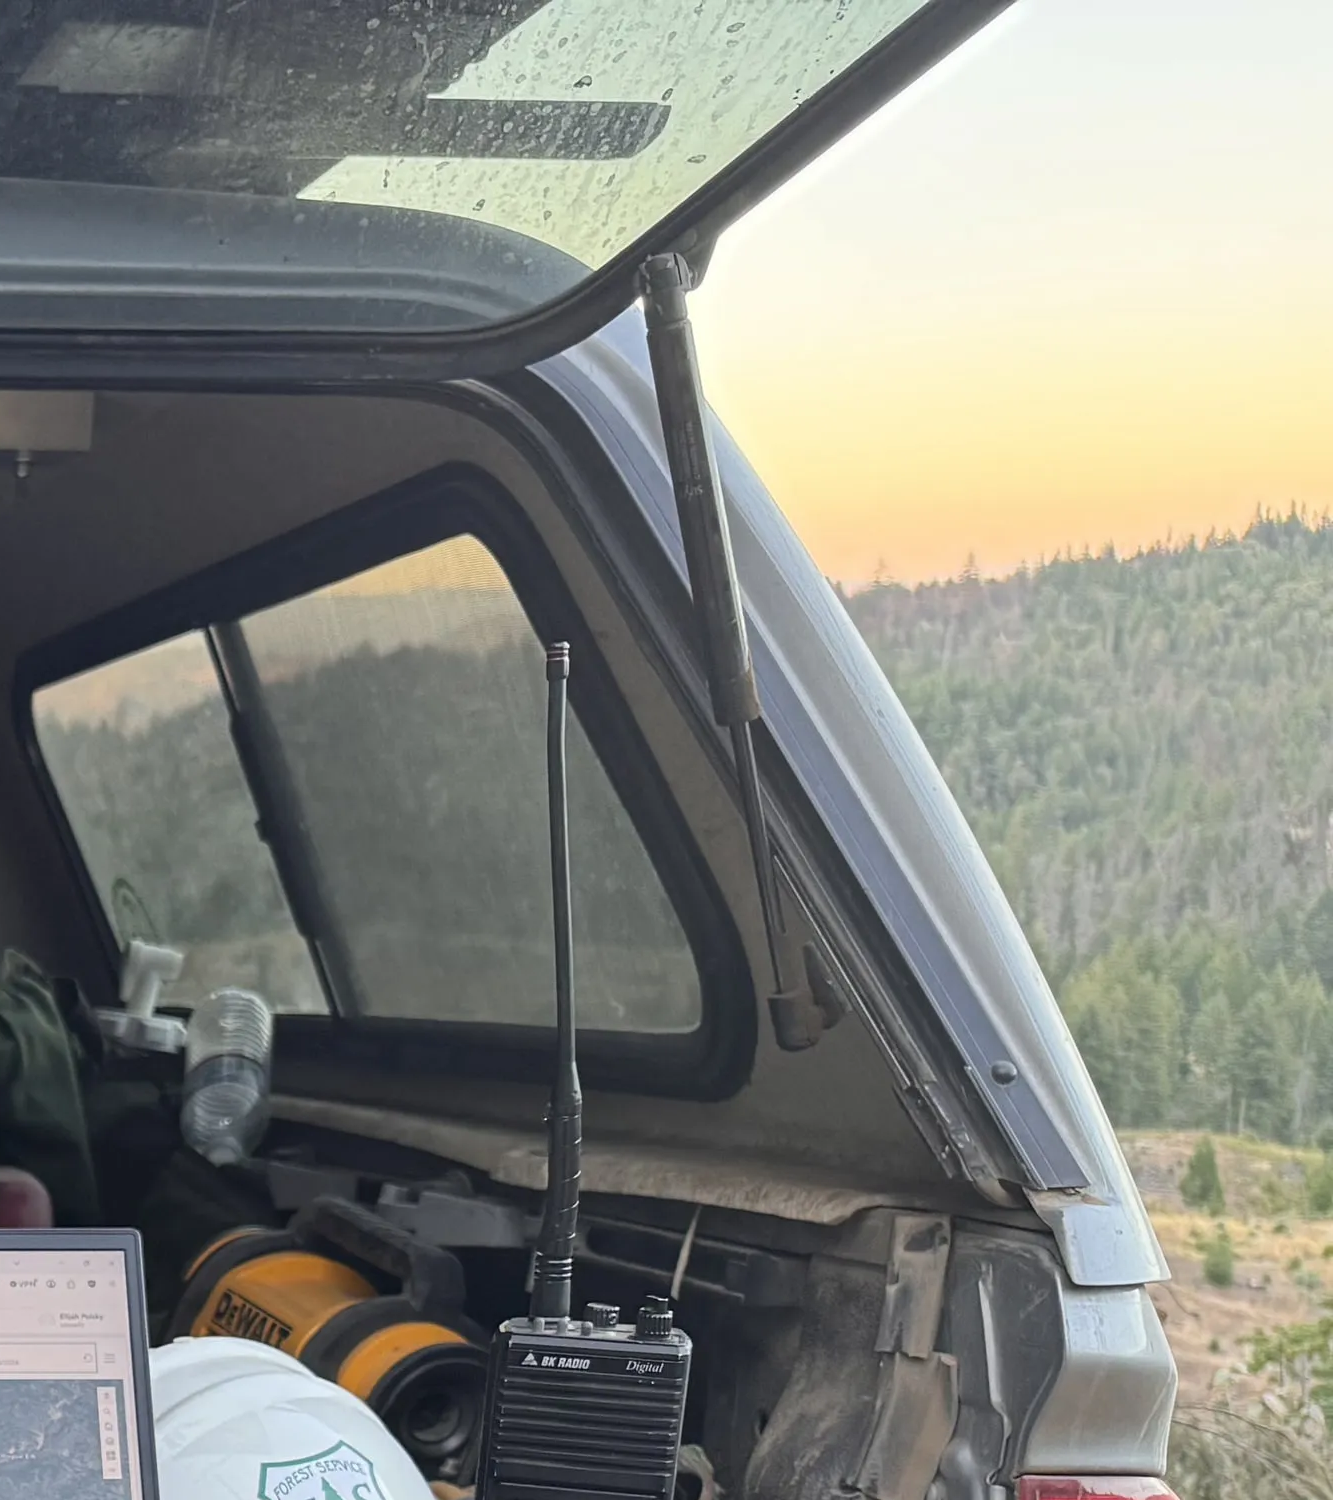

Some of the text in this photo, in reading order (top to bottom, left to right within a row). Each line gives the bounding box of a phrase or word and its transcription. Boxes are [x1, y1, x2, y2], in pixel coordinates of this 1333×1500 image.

[541, 1356, 591, 1370] BK RADIO
[625, 1359, 664, 1374] Digital
[315, 1459, 367, 1477] SERVICE
